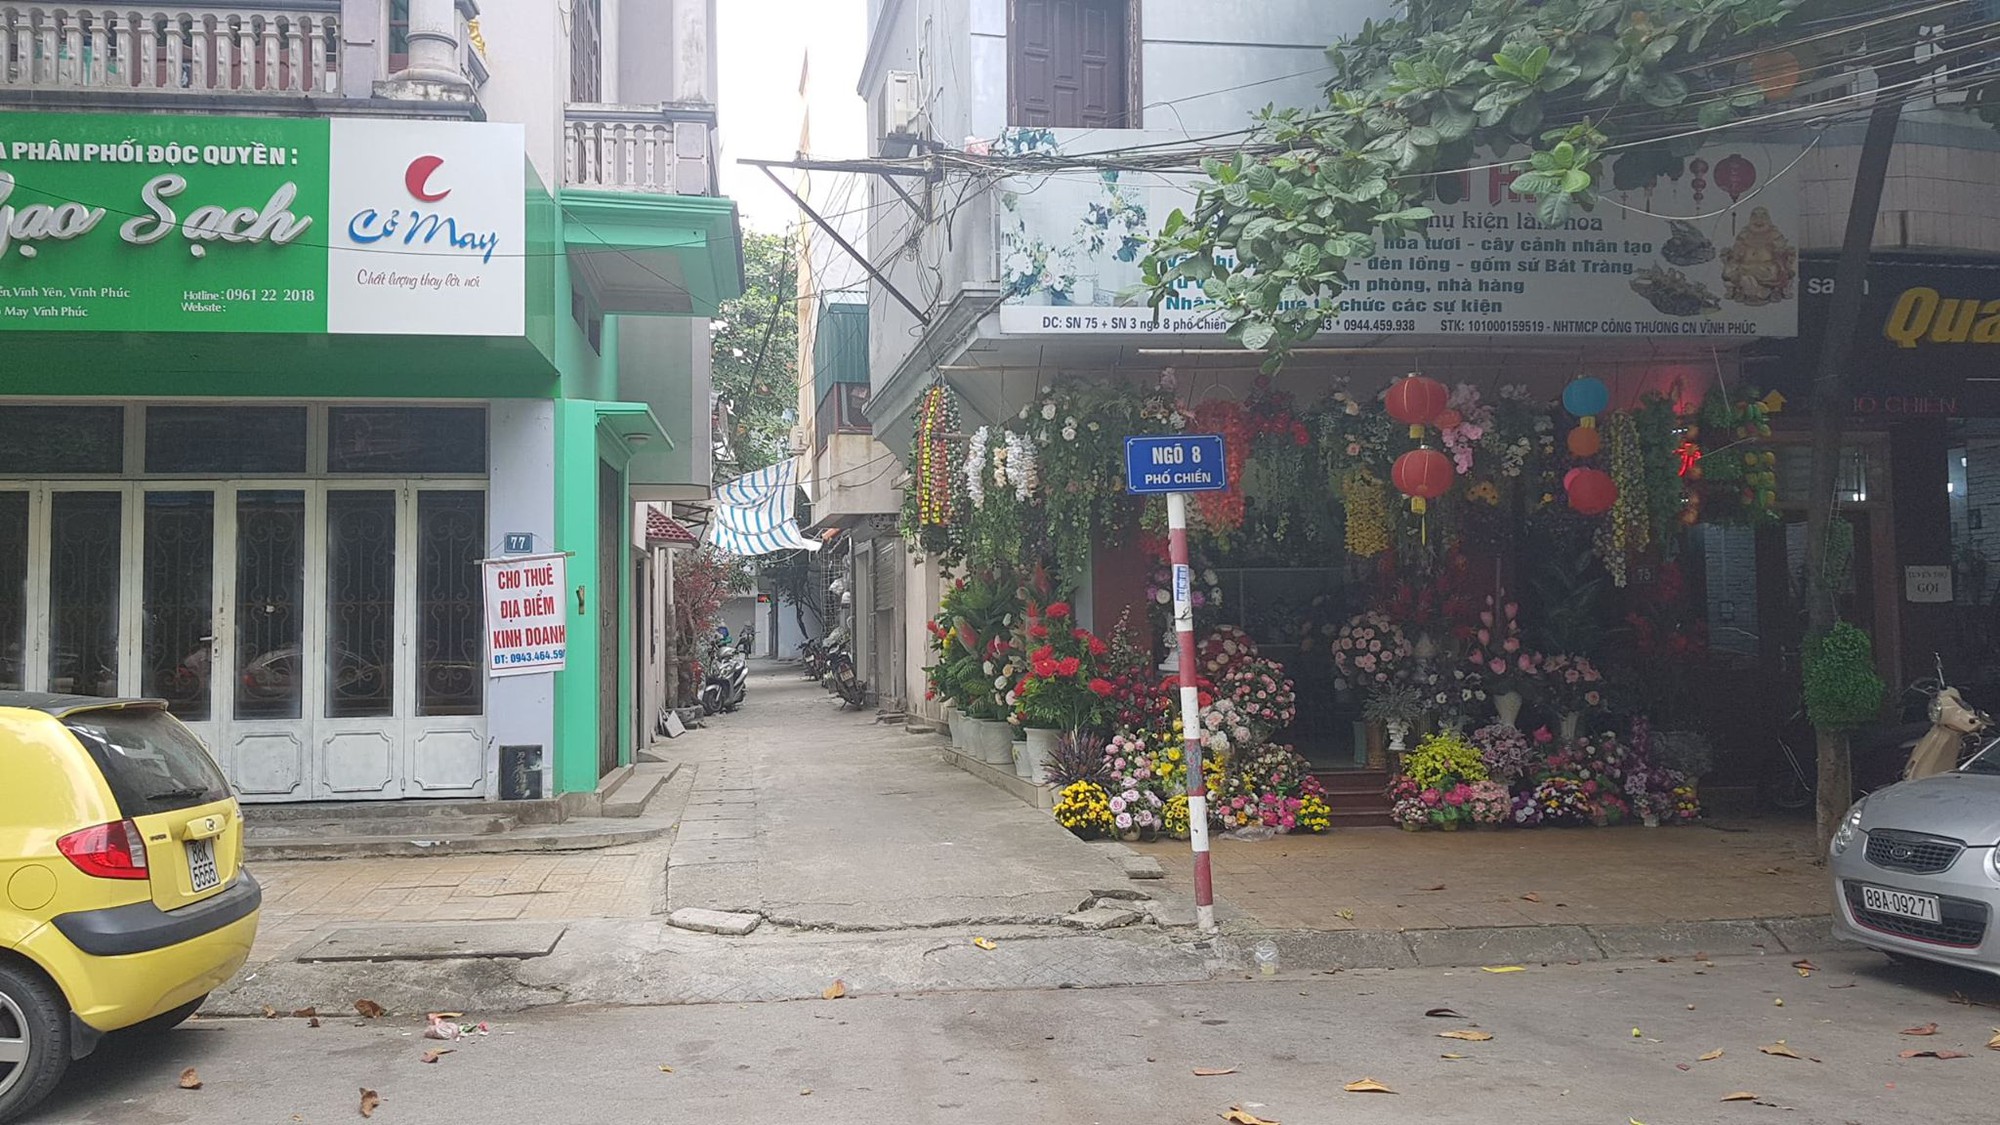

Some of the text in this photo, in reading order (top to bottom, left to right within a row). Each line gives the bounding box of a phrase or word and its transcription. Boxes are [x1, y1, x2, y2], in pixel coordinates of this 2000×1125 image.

[12, 140, 80, 160] PHÂN
[83, 136, 143, 162] PHỐI
[147, 142, 198, 166] ĐỘC
[120, 173, 313, 257] Sạch
[1463, 211, 1508, 233] kiện
[348, 208, 500, 264] Cỏ May
[1426, 237, 1461, 250] tươi
[1481, 238, 1515, 253] cây
[1520, 237, 1566, 252] cảnh
[1572, 239, 1617, 253] nhân
[1624, 240, 1652, 256] tạo
[1367, 256, 1403, 271] đèn
[1409, 256, 1451, 273] lồng
[1471, 256, 1511, 273] gốm
[1517, 257, 1541, 272] sứ
[1545, 259, 1576, 273] Bát
[1582, 260, 1633, 275] Tràng
[357, 268, 385, 286] Chất
[420, 272, 443, 291] thay
[1366, 278, 1431, 293] phòng,
[1437, 278, 1472, 292] nhà
[1478, 278, 1525, 294] hàng
[101, 287, 131, 299] Phúc
[226, 288, 257, 301] 0961
[261, 288, 277, 301] 22
[283, 289, 315, 301] 2018
[4, 306, 29, 319] May
[61, 305, 88, 317] Phúc
[1340, 296, 1385, 311] chức
[1392, 298, 1427, 312] các
[1433, 300, 1456, 315] sự
[1461, 300, 1502, 316] kiện
[1066, 317, 1081, 329] SN
[1085, 317, 1098, 330] 75
[1111, 318, 1127, 330] SN
[1130, 318, 1137, 330] 3
[1163, 318, 1170, 330] 8
[1343, 319, 1415, 331] 0944.459.938
[1440, 320, 1465, 332] STK:
[1468, 320, 1544, 332] 101000159519
[1553, 321, 1598, 332] NHTMCP
[1601, 318, 1632, 333] CÔNG
[1635, 321, 1679, 333] THƯƠNG
[1682, 322, 1697, 333] CN
[1728, 319, 1757, 334] PHÚC
[1152, 443, 1202, 465] NGÕ 8
[1145, 469, 1171, 485] PHỐ
[510, 536, 525, 549] 77
[498, 563, 554, 590] CHO THUÊ
[501, 589, 555, 623] ĐỊA ĐIỂM
[493, 624, 565, 649] KINH DOANH
[193, 862, 216, 888] 5555
